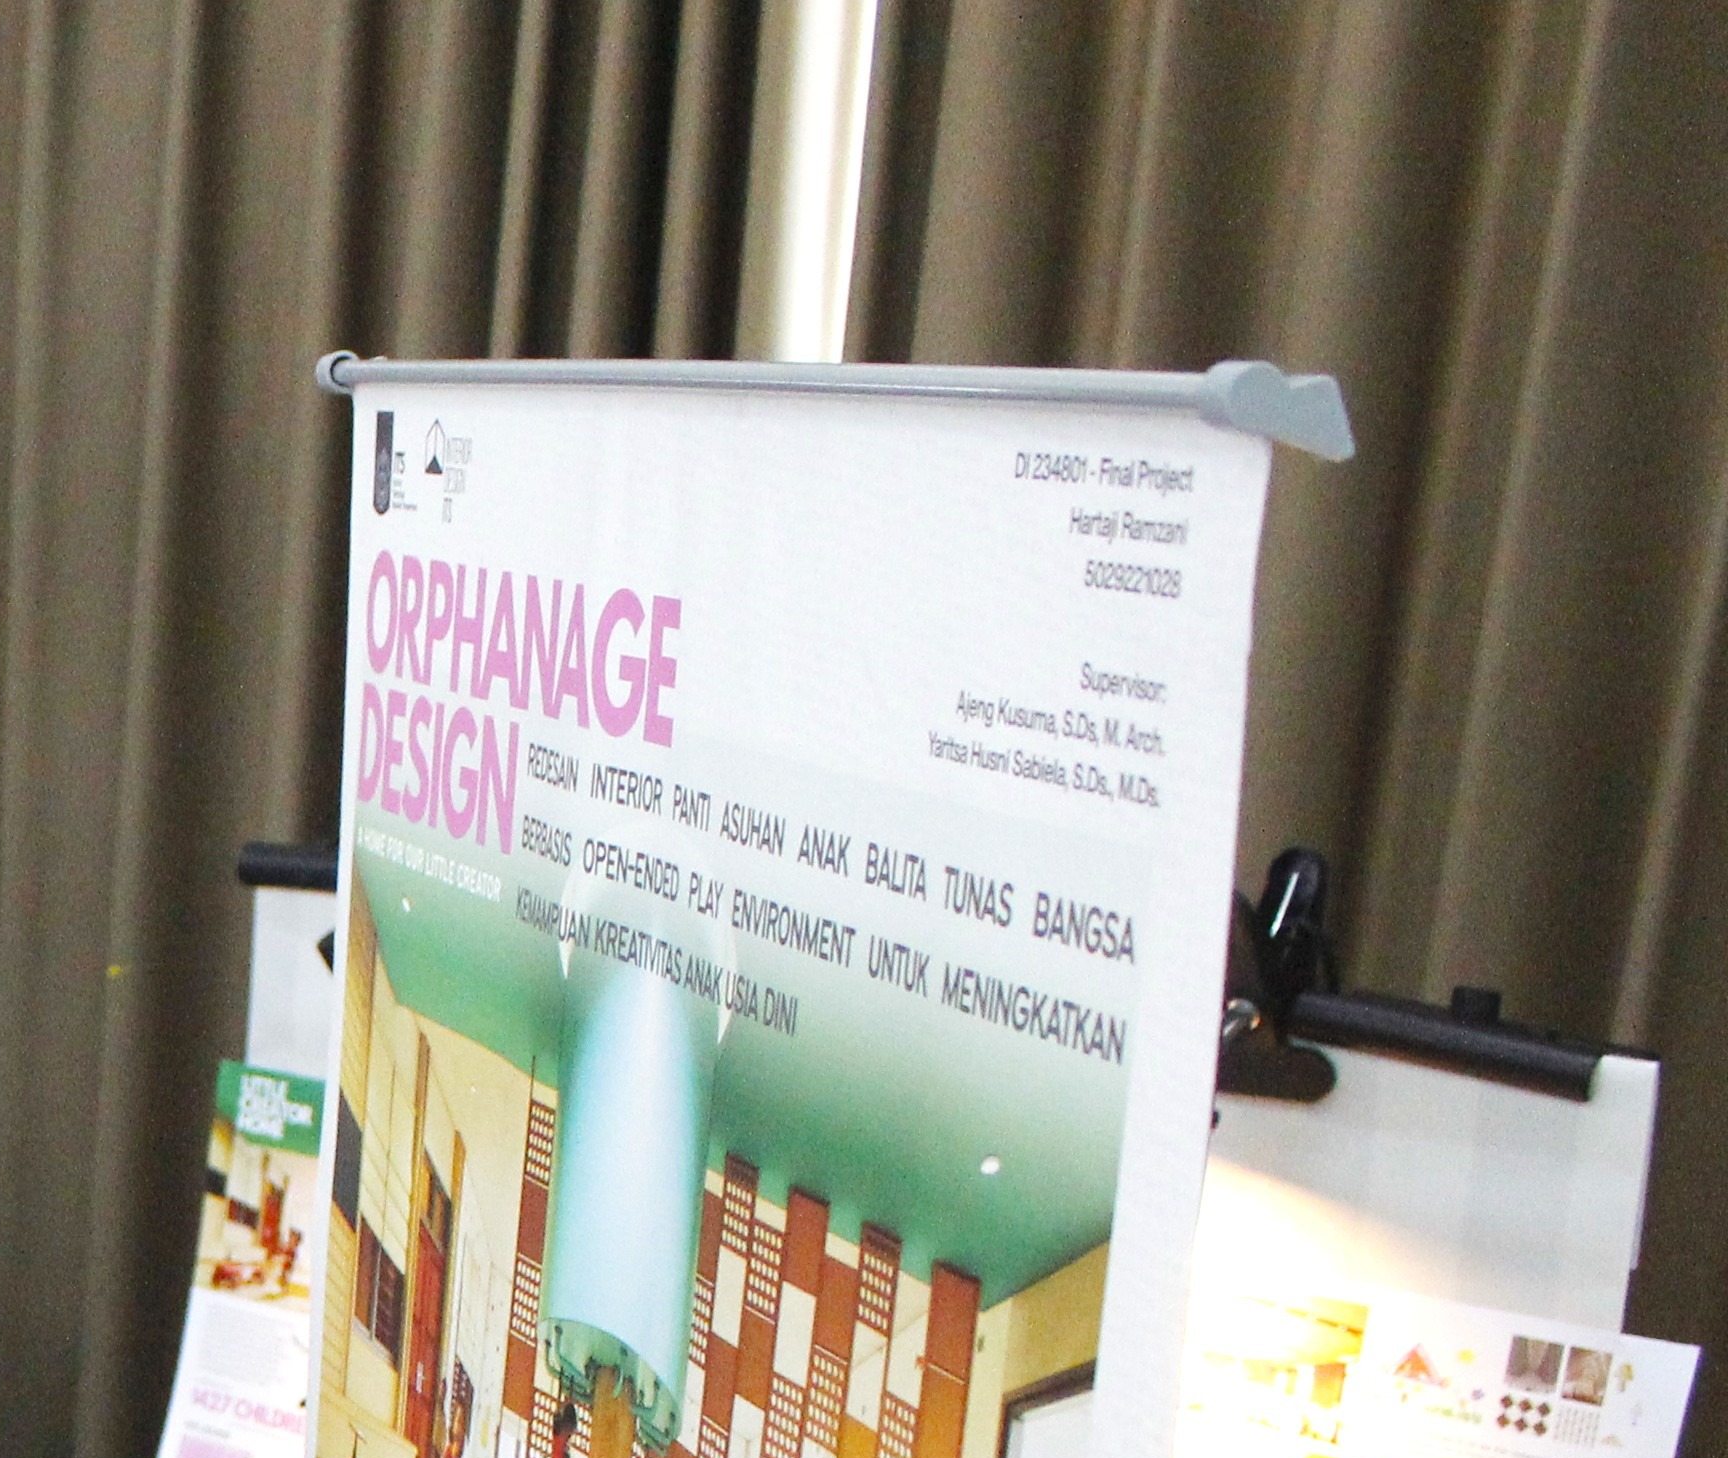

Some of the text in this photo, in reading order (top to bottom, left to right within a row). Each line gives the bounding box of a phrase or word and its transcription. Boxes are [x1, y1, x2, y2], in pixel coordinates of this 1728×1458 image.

[1015, 452, 1030, 478] DI
[1032, 453, 1088, 484] 234801
[1099, 458, 1135, 486] Final
[1136, 460, 1194, 497] Project
[1084, 559, 1182, 598] 5029221028
[366, 549, 683, 749] ORPHANAGE
[1080, 661, 1167, 703] Supervisor:
[956, 690, 994, 727] Ajeng
[357, 682, 520, 856] DESIGN
[970, 741, 1010, 774] Husni
[527, 742, 1136, 966] REDESAIN INTERIOR PANTI ASUHAN ANAK BALITA TUNAS BANGSA
[456, 861, 502, 902] CREATOR
[515, 885, 799, 1037] KEMAMPUAN KREATIVITAS ANAK USIA DINI
[521, 814, 1128, 1066] BERBASIS OPEN-ENDED PLAY ENVIRONMENT UNTUK MENINGKATKAN
